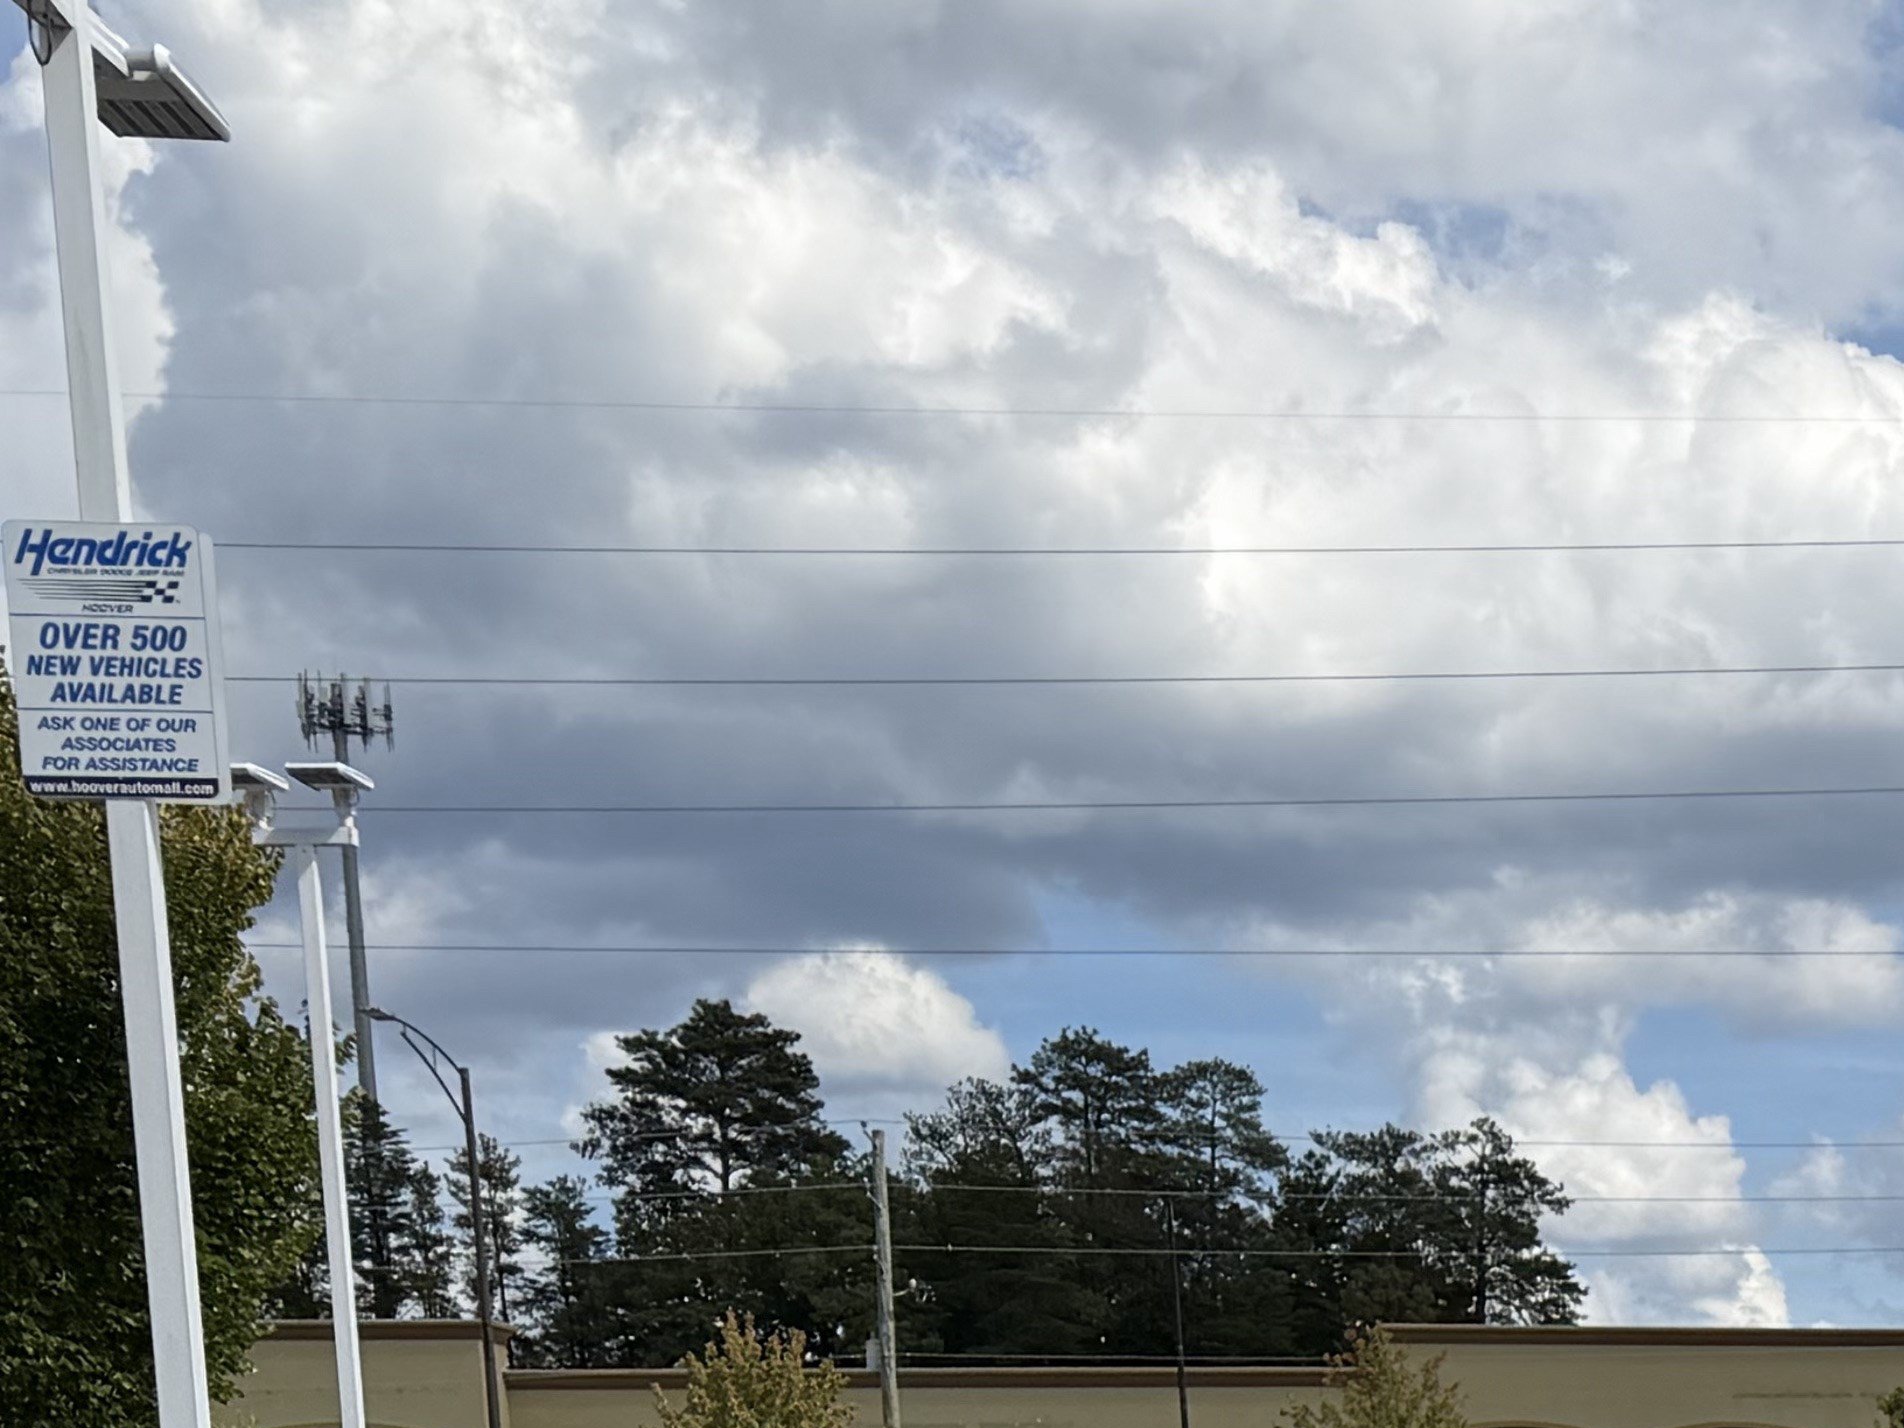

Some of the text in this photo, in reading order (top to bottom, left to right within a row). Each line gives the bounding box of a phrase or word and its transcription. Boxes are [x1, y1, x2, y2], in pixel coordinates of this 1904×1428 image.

[15, 528, 192, 576] Hendrick
[82, 603, 134, 613] HOOVER
[39, 622, 187, 652] OVER 500
[26, 655, 203, 679] NEW VEHICLES
[50, 682, 184, 705] AVAILABLE
[37, 716, 197, 733] ASK ONE OF OUR
[61, 736, 176, 752] ASSOCIATES
[41, 757, 199, 773] FOR ASSISTANCE
[30, 779, 214, 796] www.hooverautomall.com
